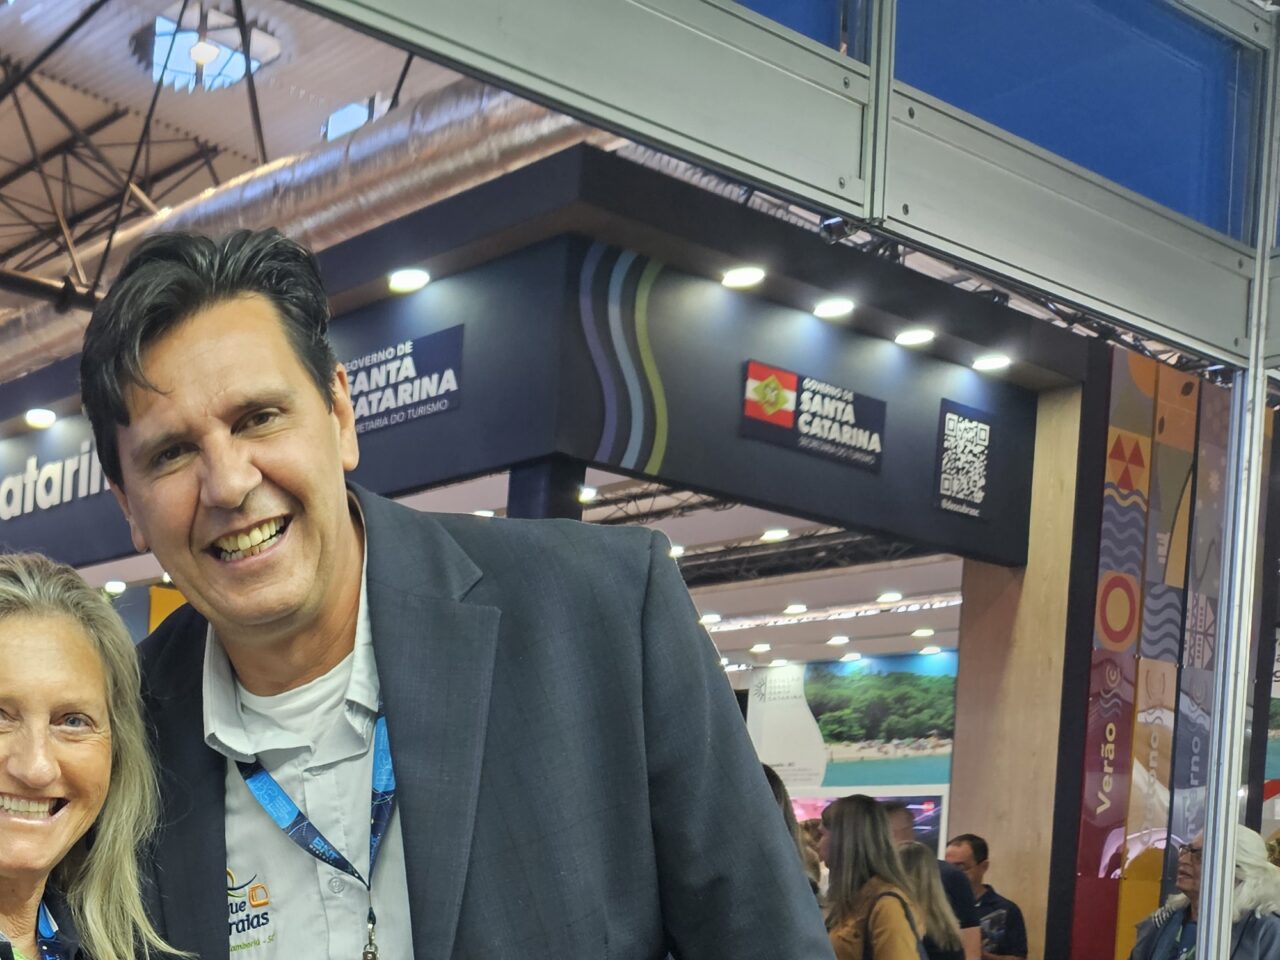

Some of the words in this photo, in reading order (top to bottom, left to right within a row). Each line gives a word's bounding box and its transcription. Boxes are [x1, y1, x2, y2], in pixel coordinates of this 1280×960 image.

[397, 340, 414, 355] DE
[352, 368, 458, 420] ATARINA
[407, 399, 448, 420] TURISMO
[799, 391, 856, 424] SANTA
[797, 412, 882, 453] CATARINA
[1096, 722, 1117, 814] Verão
